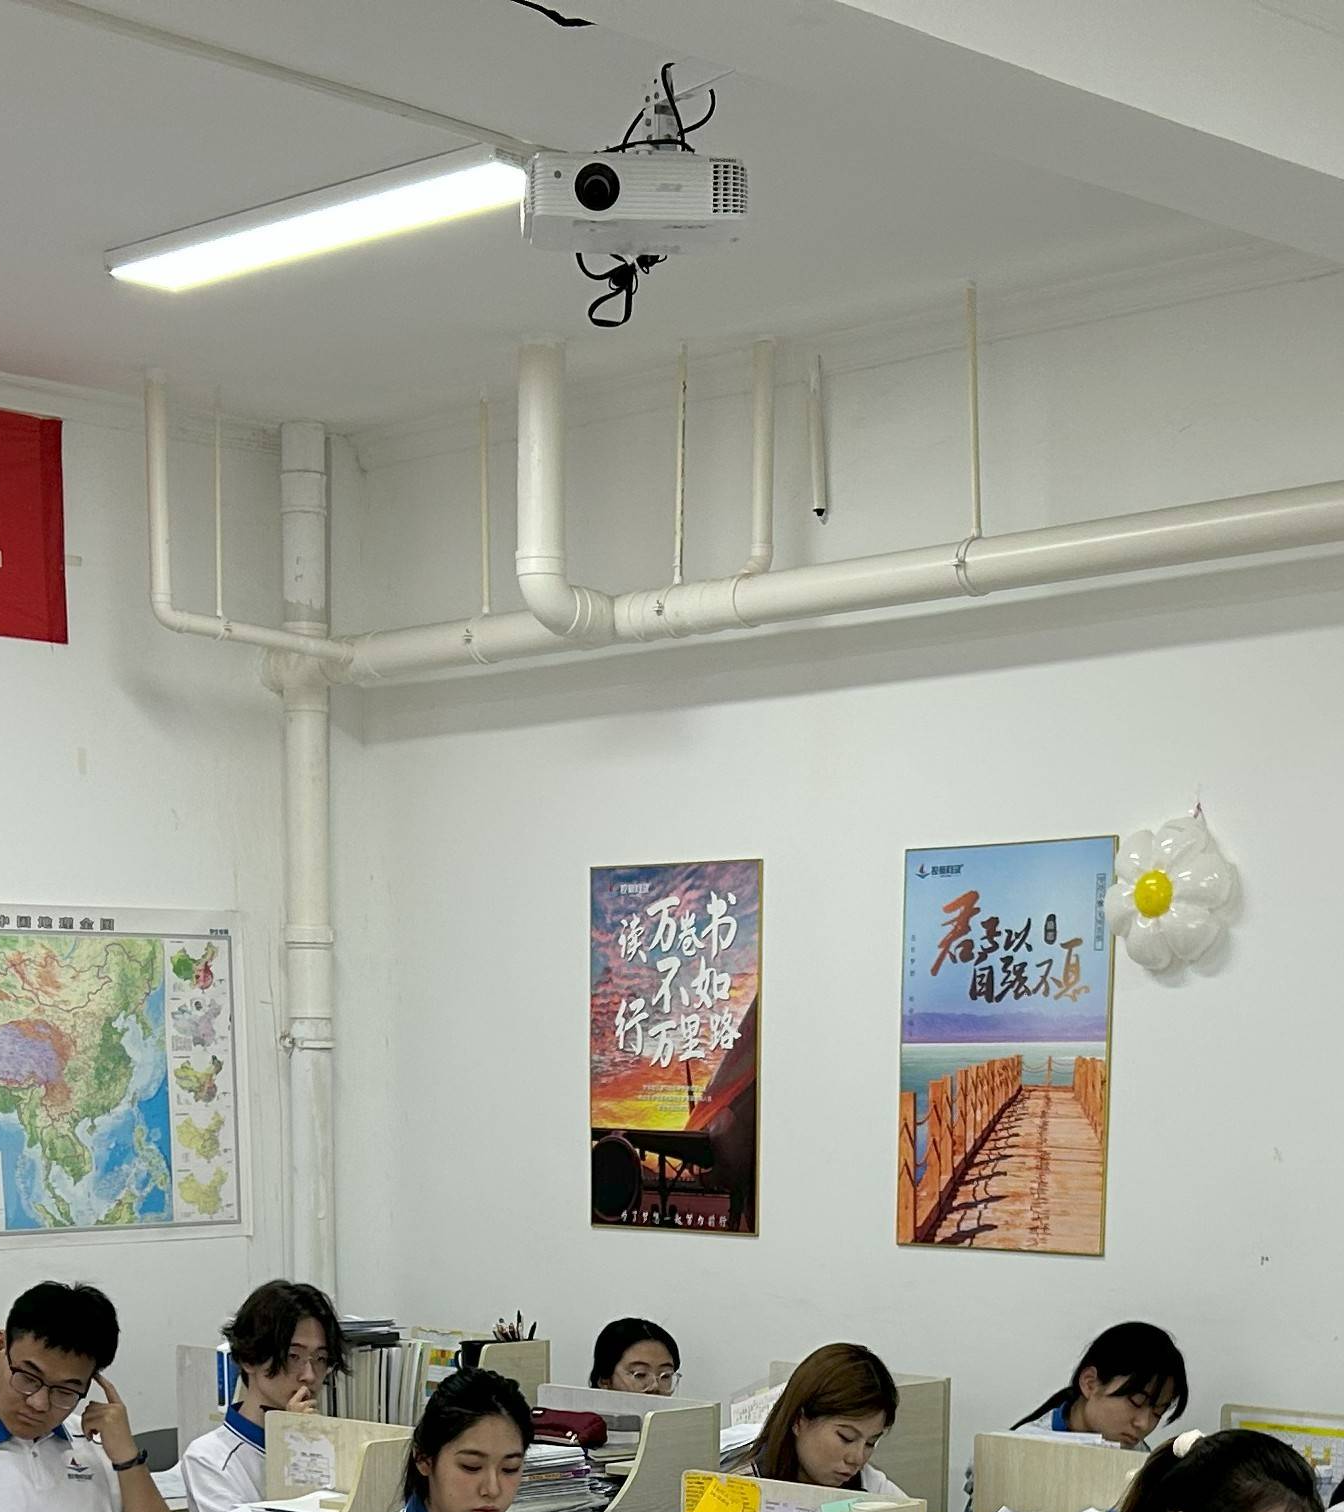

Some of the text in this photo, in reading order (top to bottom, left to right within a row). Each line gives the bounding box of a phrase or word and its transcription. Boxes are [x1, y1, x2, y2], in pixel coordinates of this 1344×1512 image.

[618, 890, 738, 964] 读万卷书
[652, 956, 732, 1014] 不如
[615, 998, 742, 1069] 行万里路
